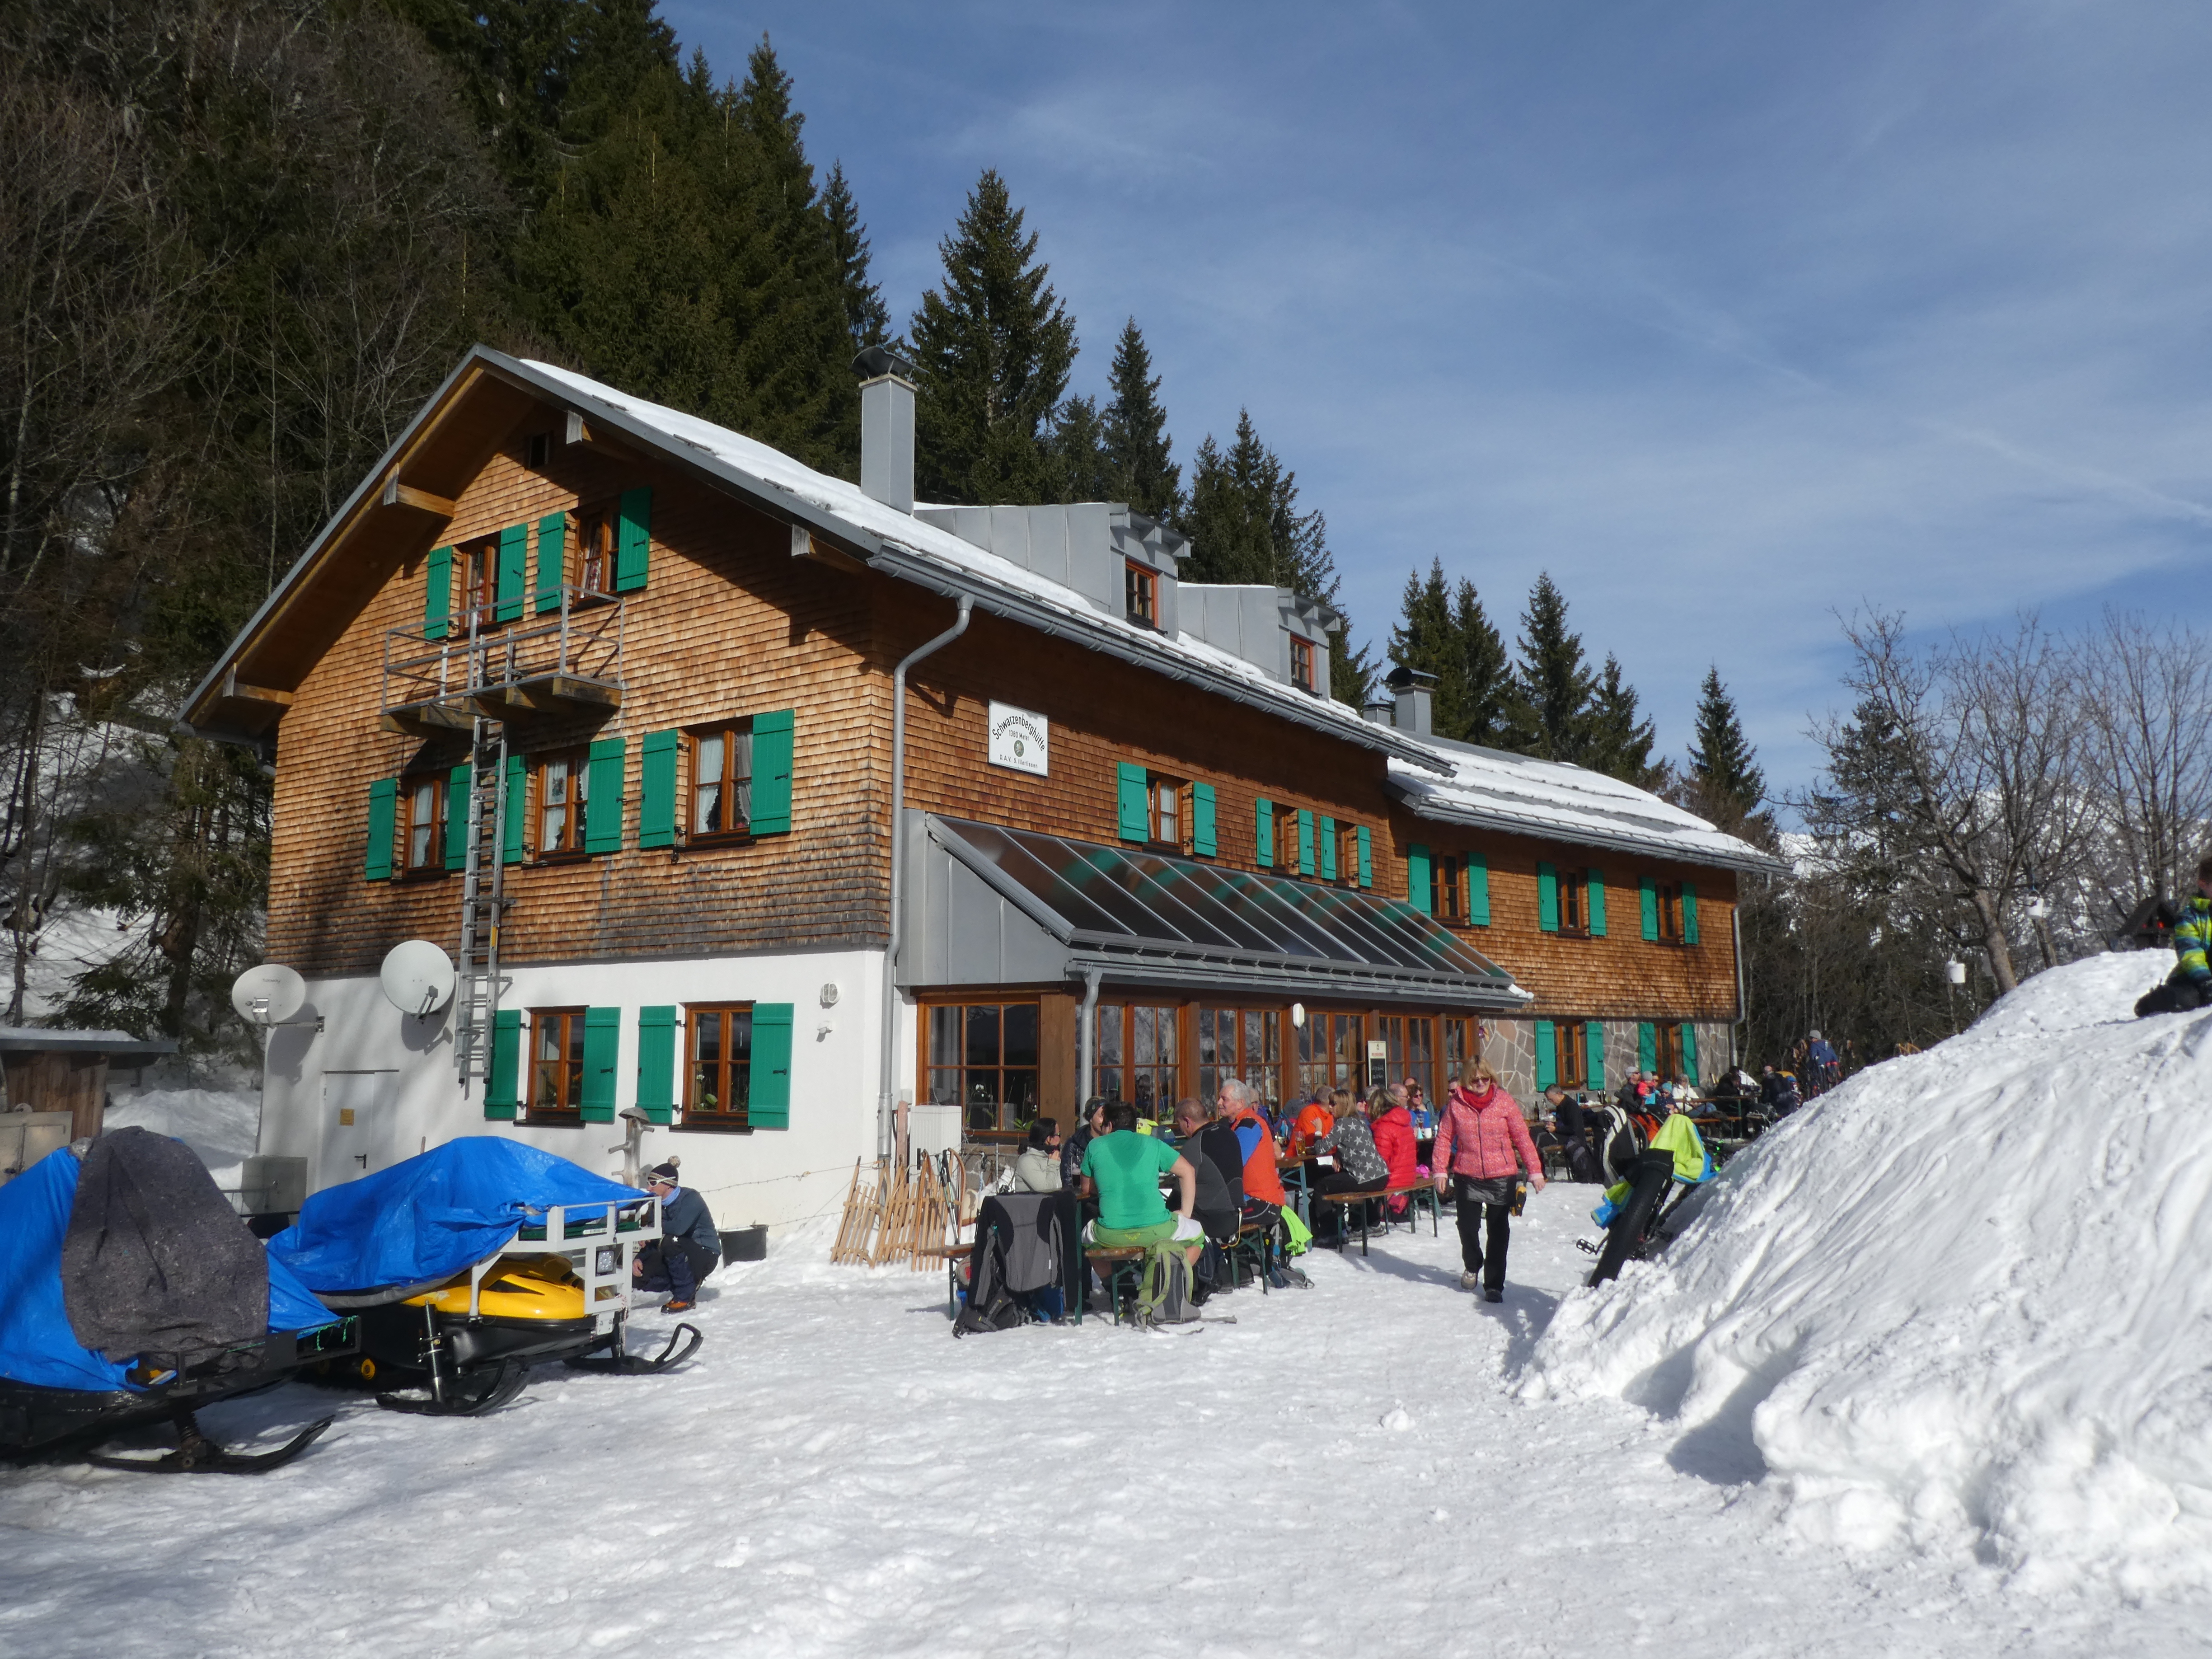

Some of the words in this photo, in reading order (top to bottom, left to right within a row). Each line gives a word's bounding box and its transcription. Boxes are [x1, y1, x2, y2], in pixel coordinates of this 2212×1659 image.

[992, 714, 1045, 752] Schwarzenberghütte
[1009, 730, 1018, 738] 1380
[1019, 732, 1029, 741] Meter
